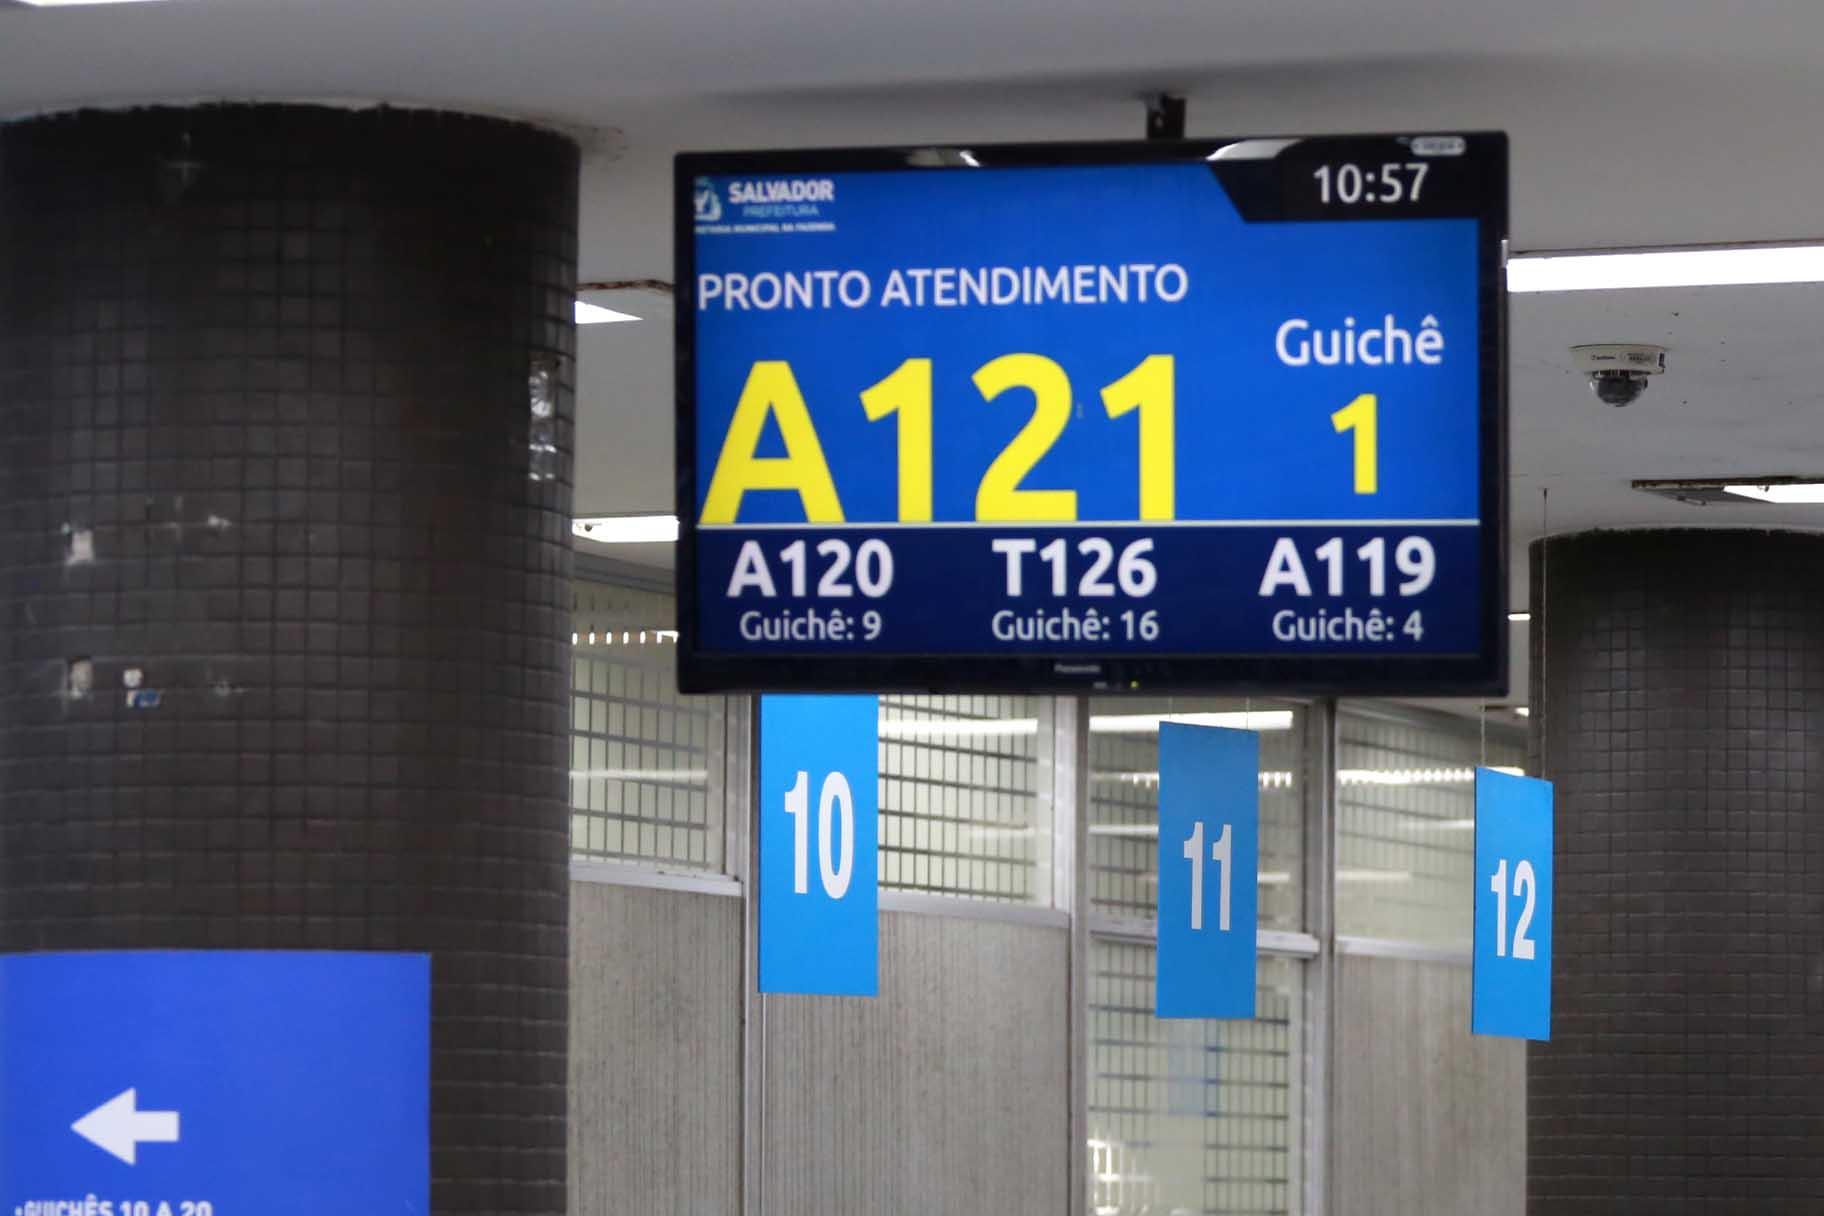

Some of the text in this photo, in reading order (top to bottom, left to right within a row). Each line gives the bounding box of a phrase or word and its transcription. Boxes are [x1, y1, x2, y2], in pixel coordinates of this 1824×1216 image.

[728, 179, 835, 204] SALVADOR
[1312, 163, 1429, 205] 10:57
[698, 263, 1189, 311] PRONTO ATENDIMENTO
[1274, 314, 1445, 367] Guichê
[699, 352, 1176, 524] A121
[1331, 393, 1379, 495] 1
[726, 538, 895, 599] A120
[991, 537, 1159, 598] T126
[1258, 536, 1437, 597] A119
[739, 609, 882, 642] Guichê: 9
[992, 609, 1159, 642] Guichê: 16
[1272, 609, 1424, 642] Guichê: 4
[784, 770, 855, 900] 10
[1183, 821, 1232, 932] 11
[1490, 858, 1536, 961] 12
